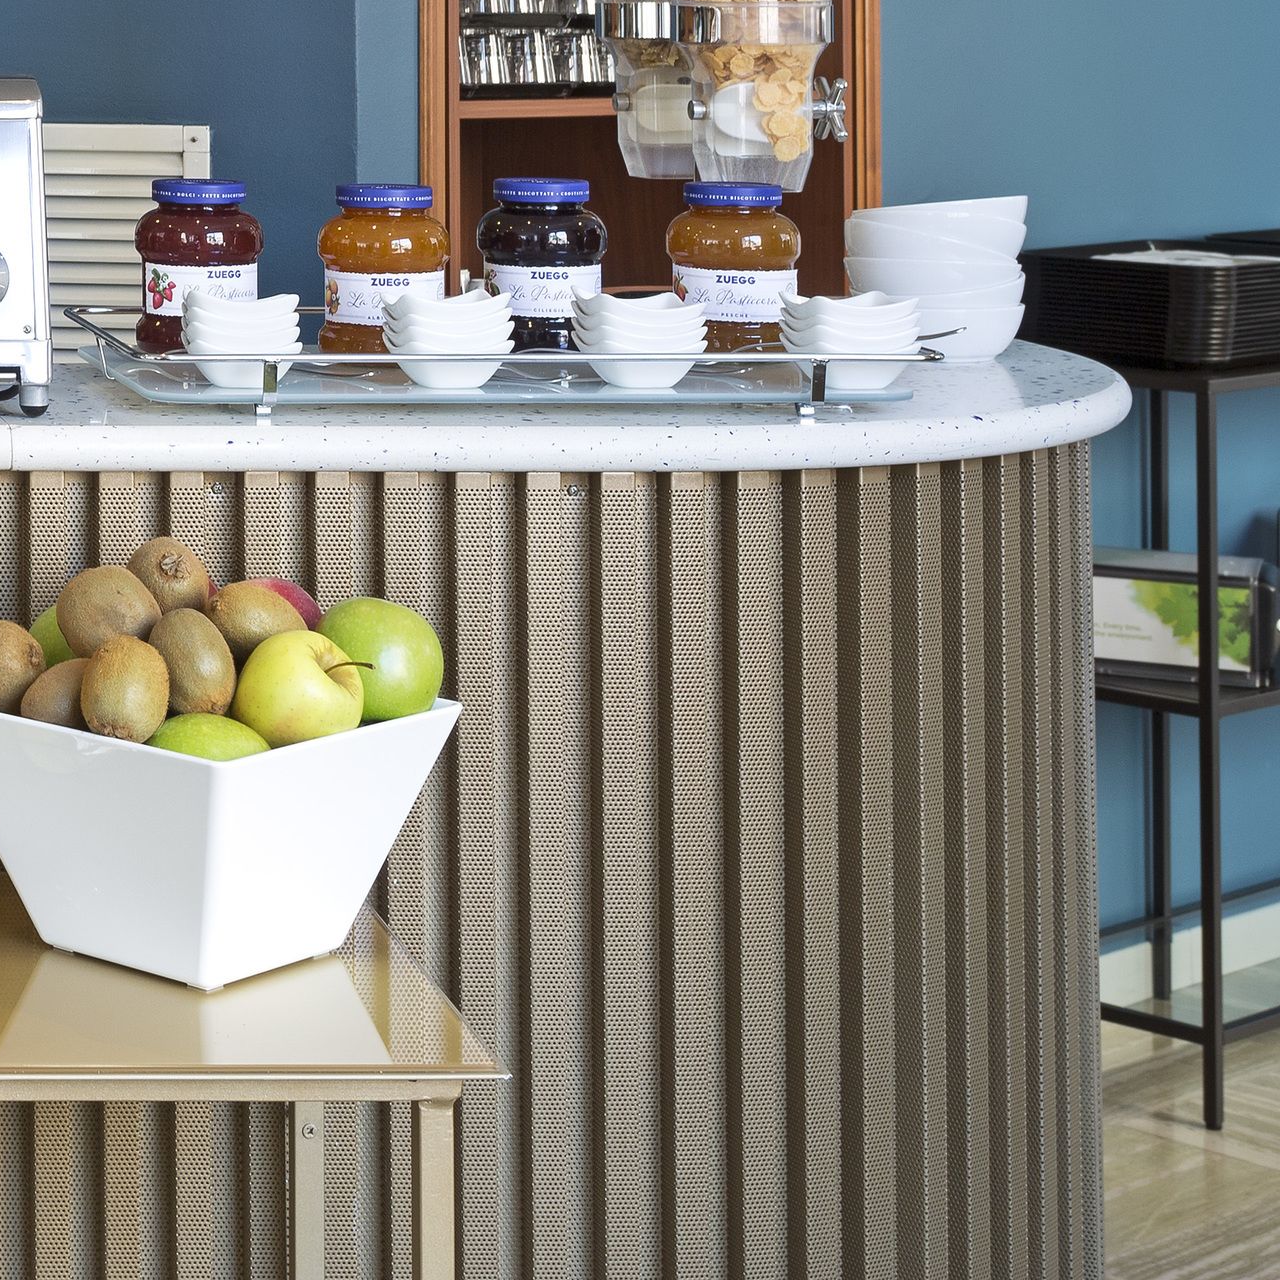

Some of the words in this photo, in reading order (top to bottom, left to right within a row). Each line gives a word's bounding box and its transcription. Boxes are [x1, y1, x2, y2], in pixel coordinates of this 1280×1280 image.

[208, 270, 241, 279] ZUEGG
[531, 272, 569, 280] ZUEGG
[371, 278, 410, 286] ZUEGG
[716, 275, 756, 284] ZUEGG
[509, 284, 525, 300] La
[692, 288, 711, 304] La
[716, 289, 778, 305] Pasticcera
[348, 290, 367, 308] La
